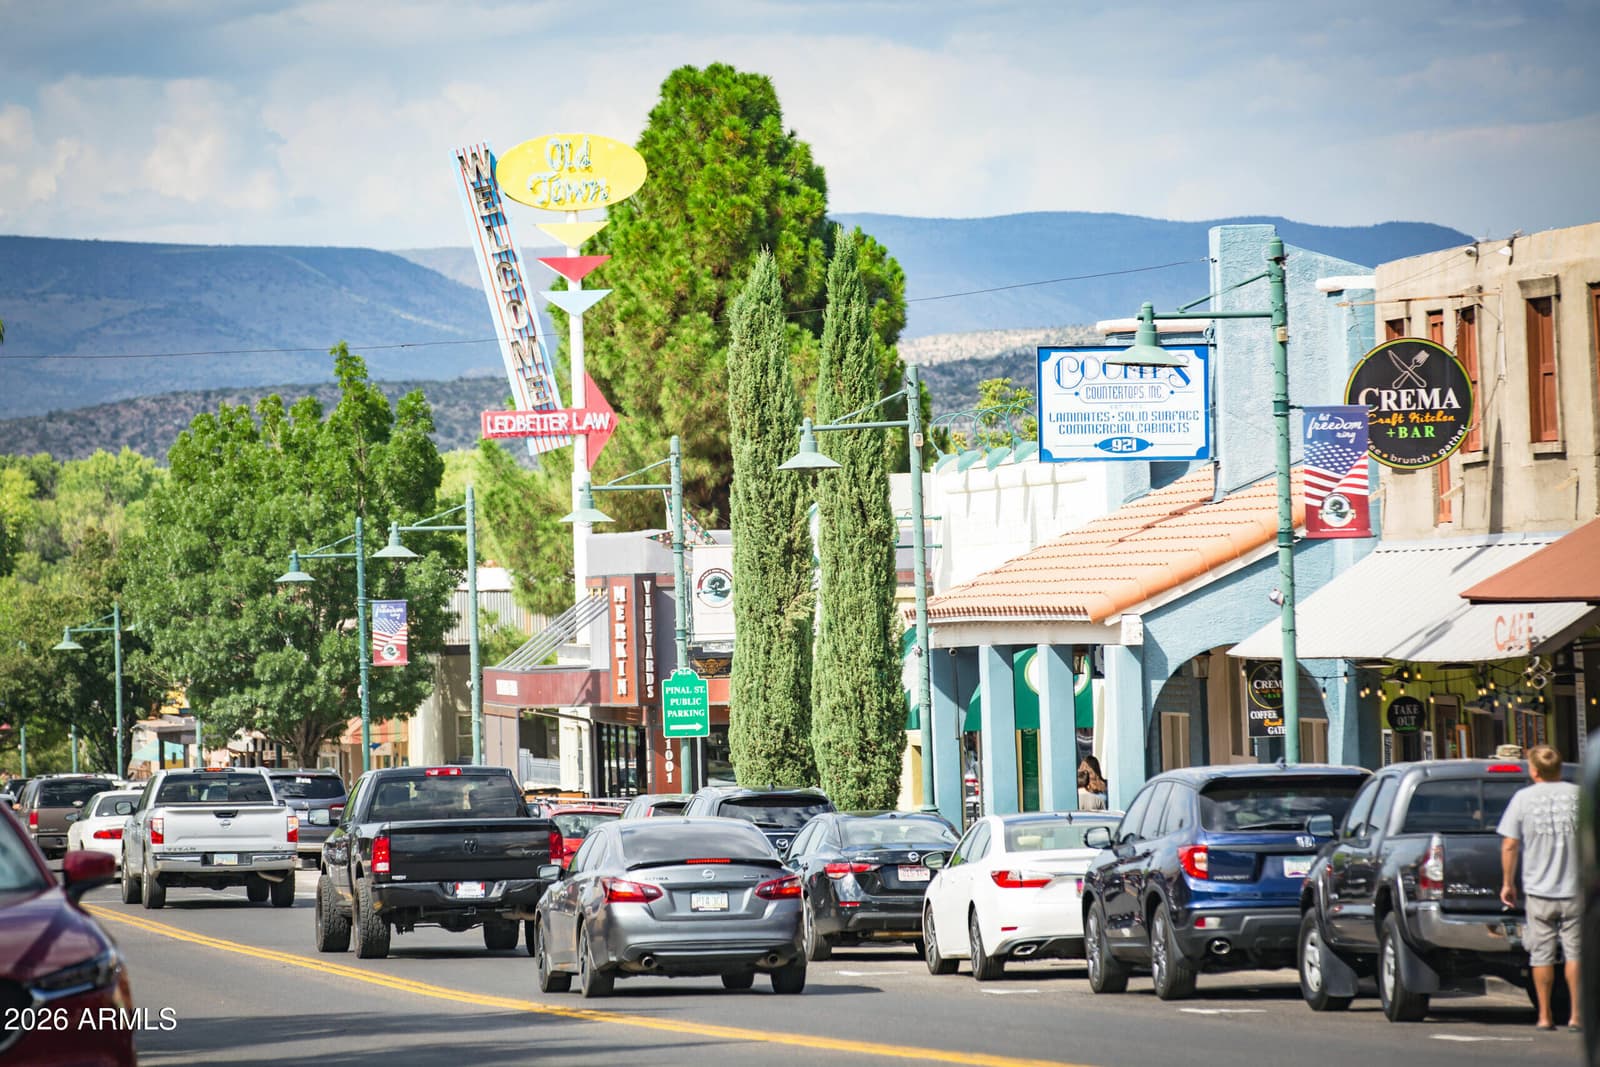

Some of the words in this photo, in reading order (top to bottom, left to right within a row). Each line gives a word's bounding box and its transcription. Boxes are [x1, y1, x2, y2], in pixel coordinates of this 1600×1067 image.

[545, 135, 592, 172] Old
[458, 148, 550, 405] WELCOME
[1086, 385, 1144, 399] COUNTERTOPS
[1358, 387, 1462, 412] CREMA
[486, 412, 569, 434] LEDBETTER
[572, 411, 611, 431] LAW
[1049, 411, 1110, 422] LAMINATES
[1117, 410, 1148, 421] SOLID
[1151, 410, 1200, 421] SURFACE
[1367, 412, 1405, 426] Craft
[1408, 410, 1456, 423] Kitchen
[1058, 423, 1134, 435] COMMERCIAL
[1137, 422, 1190, 433] CABINETS
[1306, 416, 1364, 439] freedom
[1111, 438, 1137, 452] 921
[1390, 453, 1430, 464] brunch
[1438, 424, 1468, 457] gather
[613, 585, 627, 696] MERKIN
[643, 580, 655, 698] VINEYARDS
[665, 686, 692, 695] PINAL
[694, 685, 706, 694] ST.
[1254, 680, 1283, 689] CREM
[670, 697, 702, 706] PUBLIC
[667, 709, 705, 718] PARKING
[1392, 704, 1420, 715] TAKE
[1396, 715, 1417, 726] OUT
[664, 738, 674, 784] 1001
